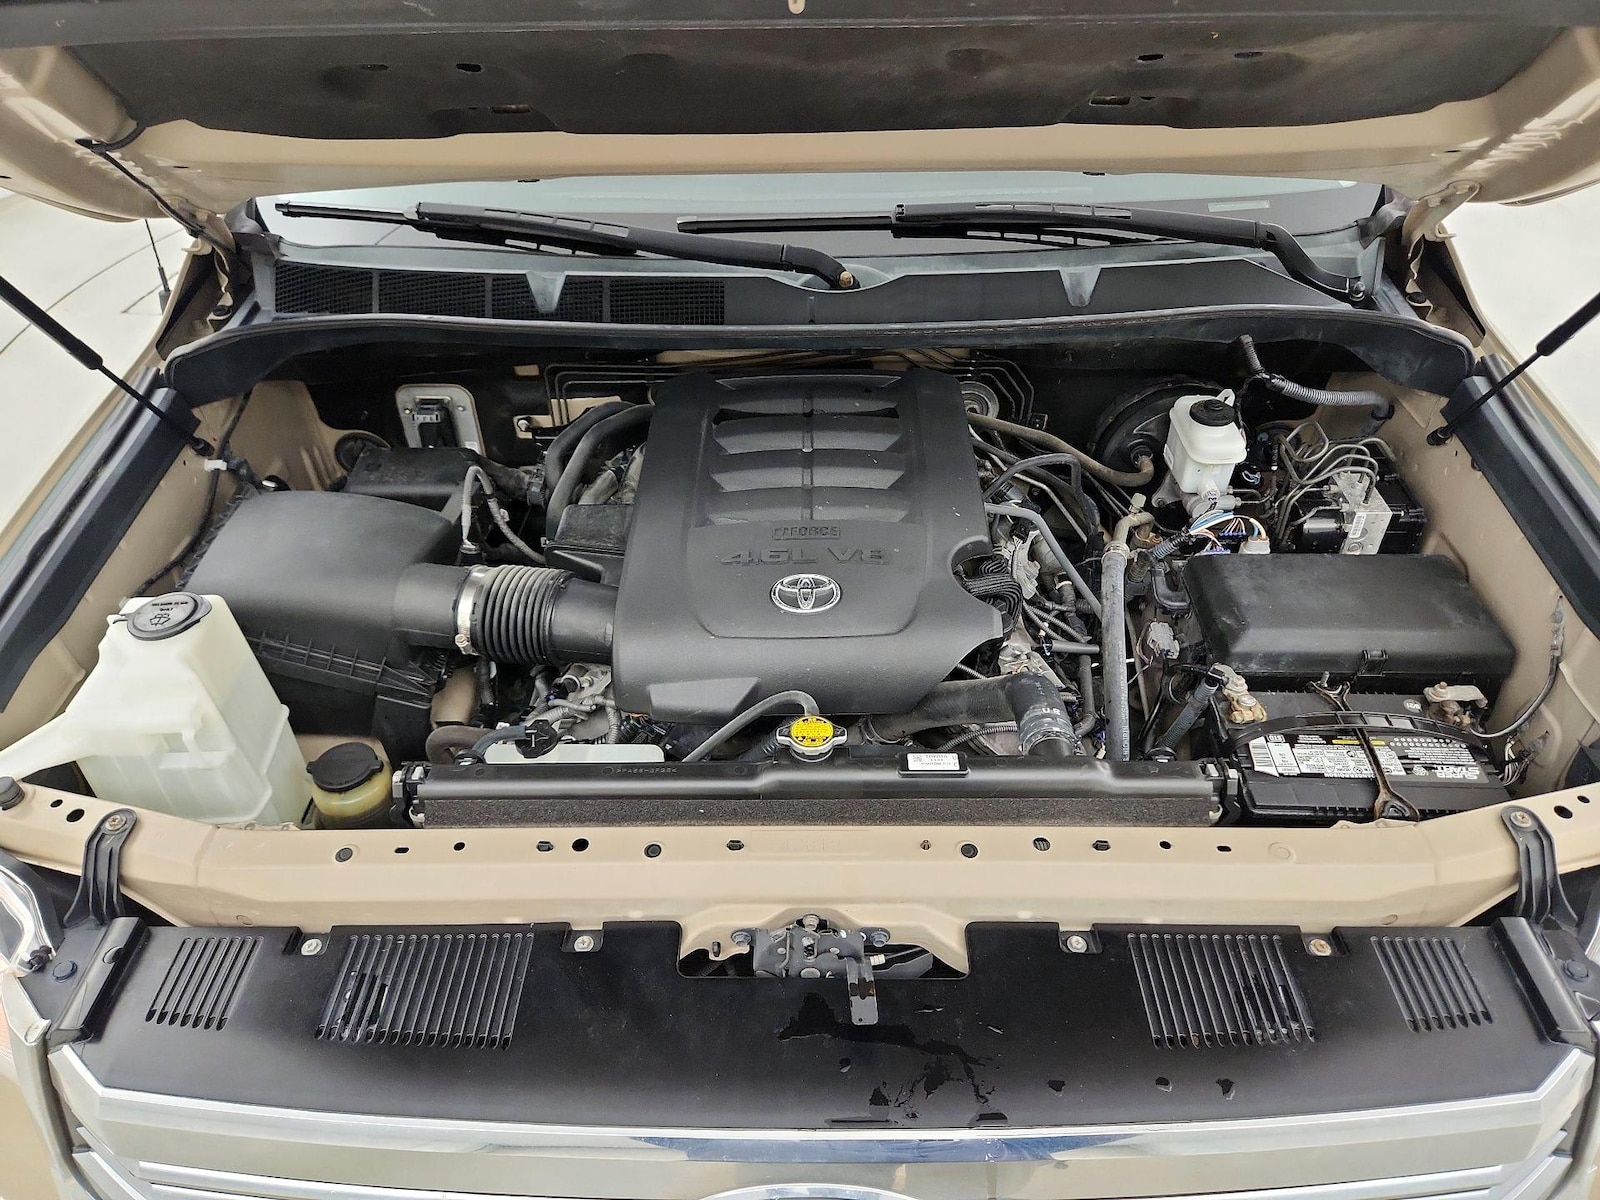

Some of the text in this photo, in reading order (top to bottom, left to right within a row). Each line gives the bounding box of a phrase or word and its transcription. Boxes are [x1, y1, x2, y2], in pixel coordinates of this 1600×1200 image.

[826, 546, 891, 566] V8
[1435, 765, 1480, 775] START
[1436, 772, 1478, 780] SUPER
